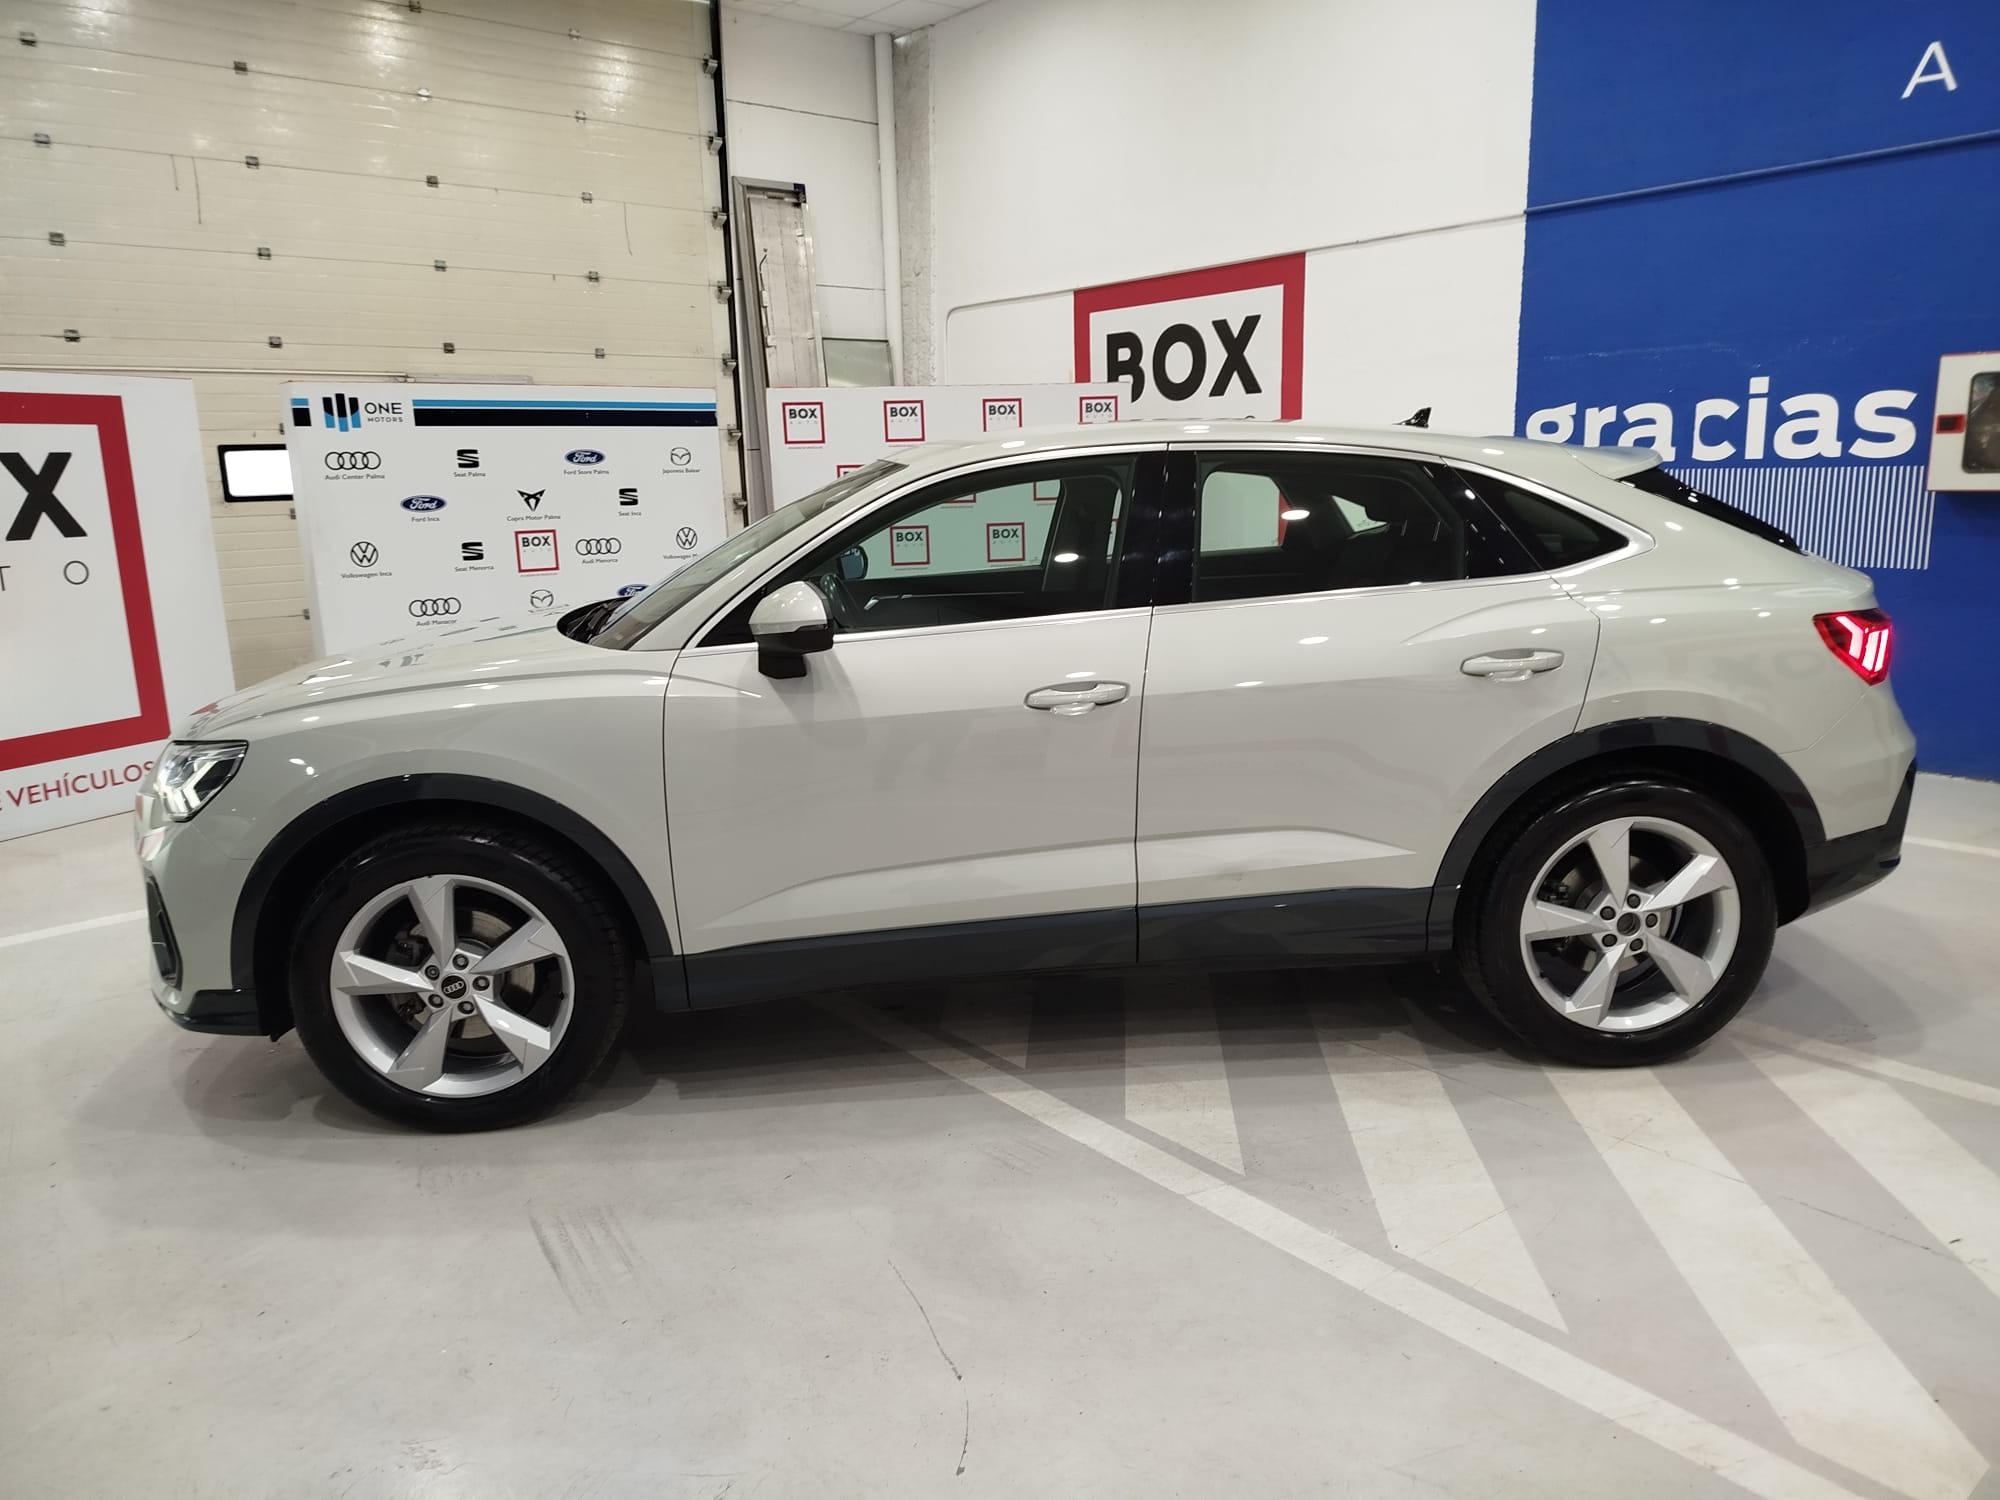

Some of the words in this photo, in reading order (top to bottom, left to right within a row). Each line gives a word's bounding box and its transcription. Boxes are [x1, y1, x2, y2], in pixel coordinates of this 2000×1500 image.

[1901, 40, 1958, 99] A
[1106, 314, 1263, 403] BOX
[364, 402, 404, 415] ONE
[788, 408, 818, 419] BOX
[889, 406, 918, 417] BOX
[988, 404, 1017, 415] BOX
[1085, 402, 1113, 413] BOX
[1525, 375, 1918, 462] gracias
[571, 452, 598, 464] Ford
[409, 497, 438, 510] Ford
[895, 531, 924, 542] BOX
[992, 528, 1020, 539] BOX
[521, 536, 551, 548] BOX
